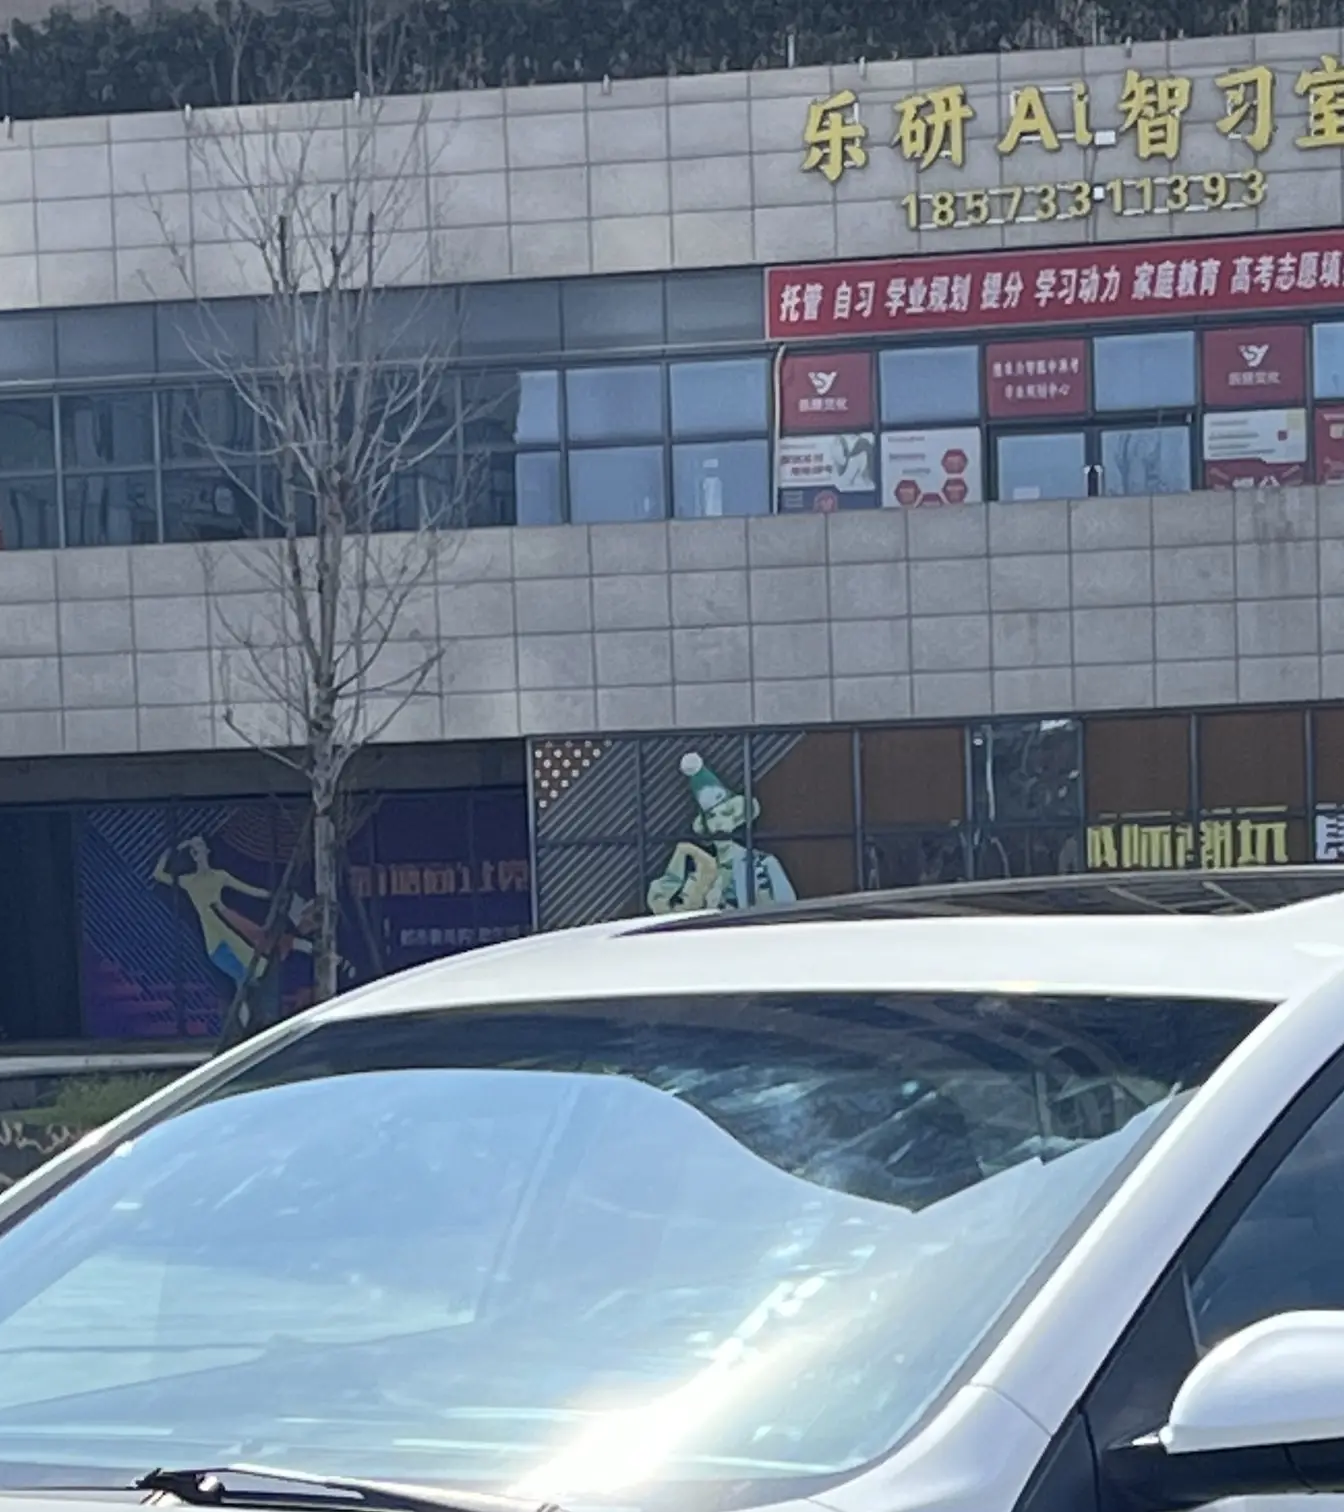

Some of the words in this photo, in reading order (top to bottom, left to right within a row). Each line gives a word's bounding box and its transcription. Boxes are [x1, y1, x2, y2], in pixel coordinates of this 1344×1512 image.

[901, 169, 1267, 230] 18573311393
[780, 283, 826, 322] 托管
[834, 280, 876, 319] 自习
[885, 273, 972, 316] 学业规划
[980, 271, 1024, 310] 提分
[1035, 264, 1121, 307] 学习动力
[1131, 257, 1221, 300] 家庭教育
